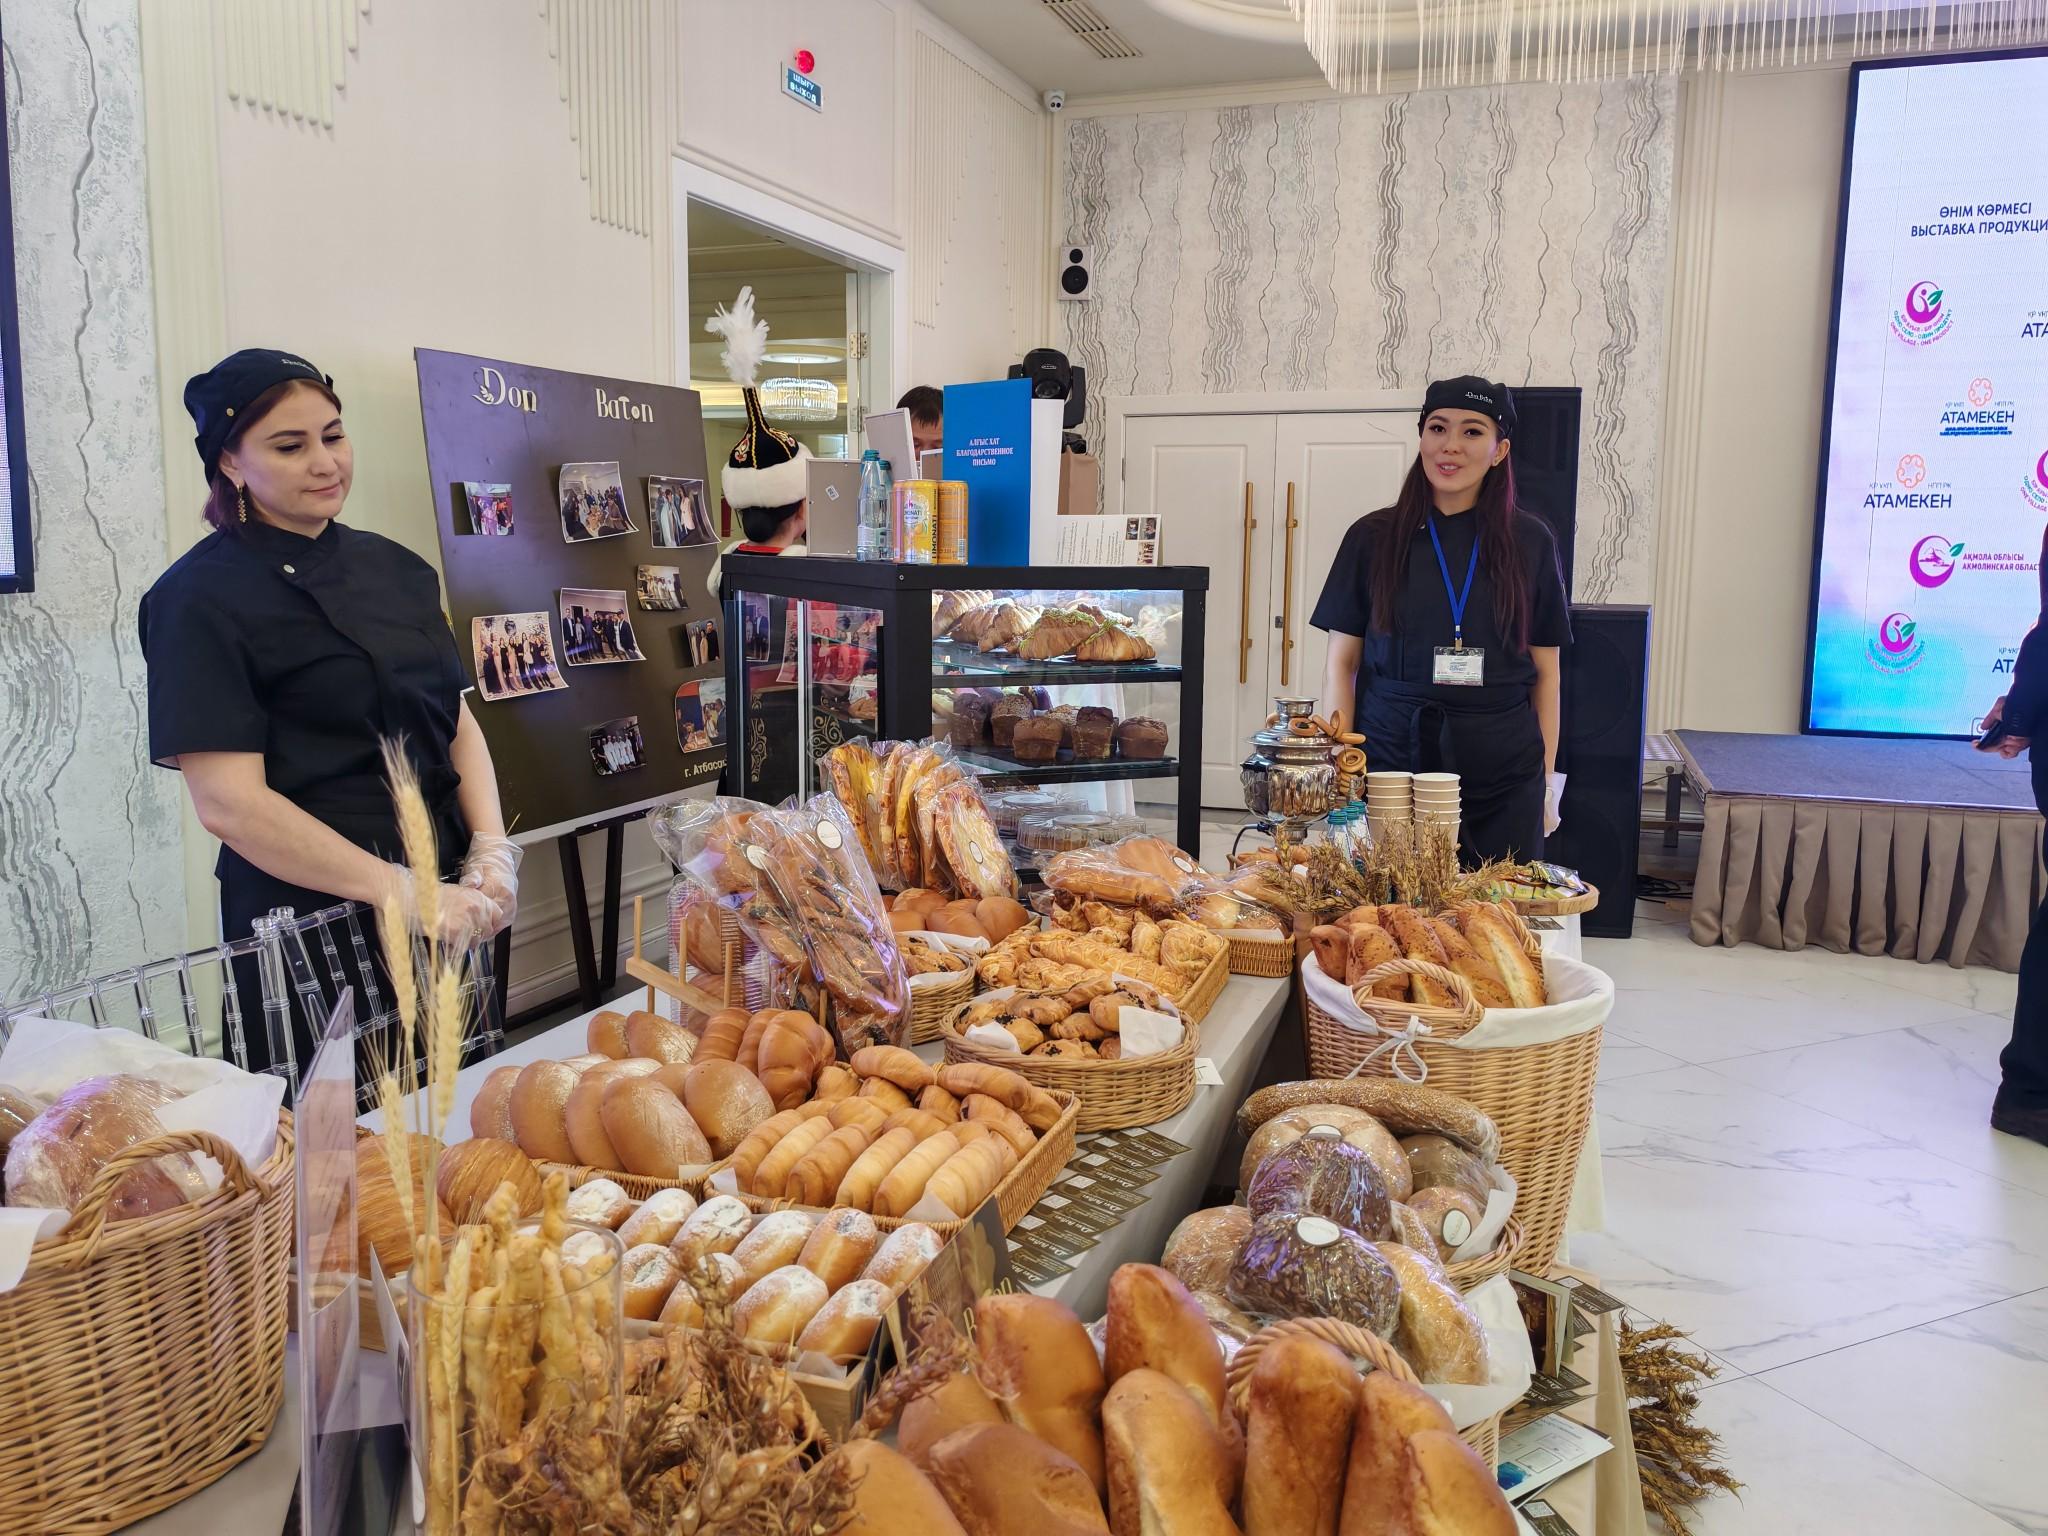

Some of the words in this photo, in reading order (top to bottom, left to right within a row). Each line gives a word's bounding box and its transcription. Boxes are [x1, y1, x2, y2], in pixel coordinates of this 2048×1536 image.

[1939, 205, 1974, 218] ӨНІМ
[1976, 202, 2032, 217] КӨРМЕСІ
[1911, 222, 1975, 237] ВЫСТАВКА
[472, 366, 537, 413] Don
[1940, 410, 2015, 424] АТАМЕКЕН
[956, 447, 1014, 457] БЛАГОДАРСТВЕННОЕ
[972, 458, 996, 467] ПИСЬМО
[1863, 493, 1952, 508] АТАМЕКЕН
[1962, 553, 1992, 562] АҚМОЛА
[1993, 553, 2024, 561] ОБЛЫСЫ
[1962, 562, 2014, 571] АКМОЛИНСКАЯ
